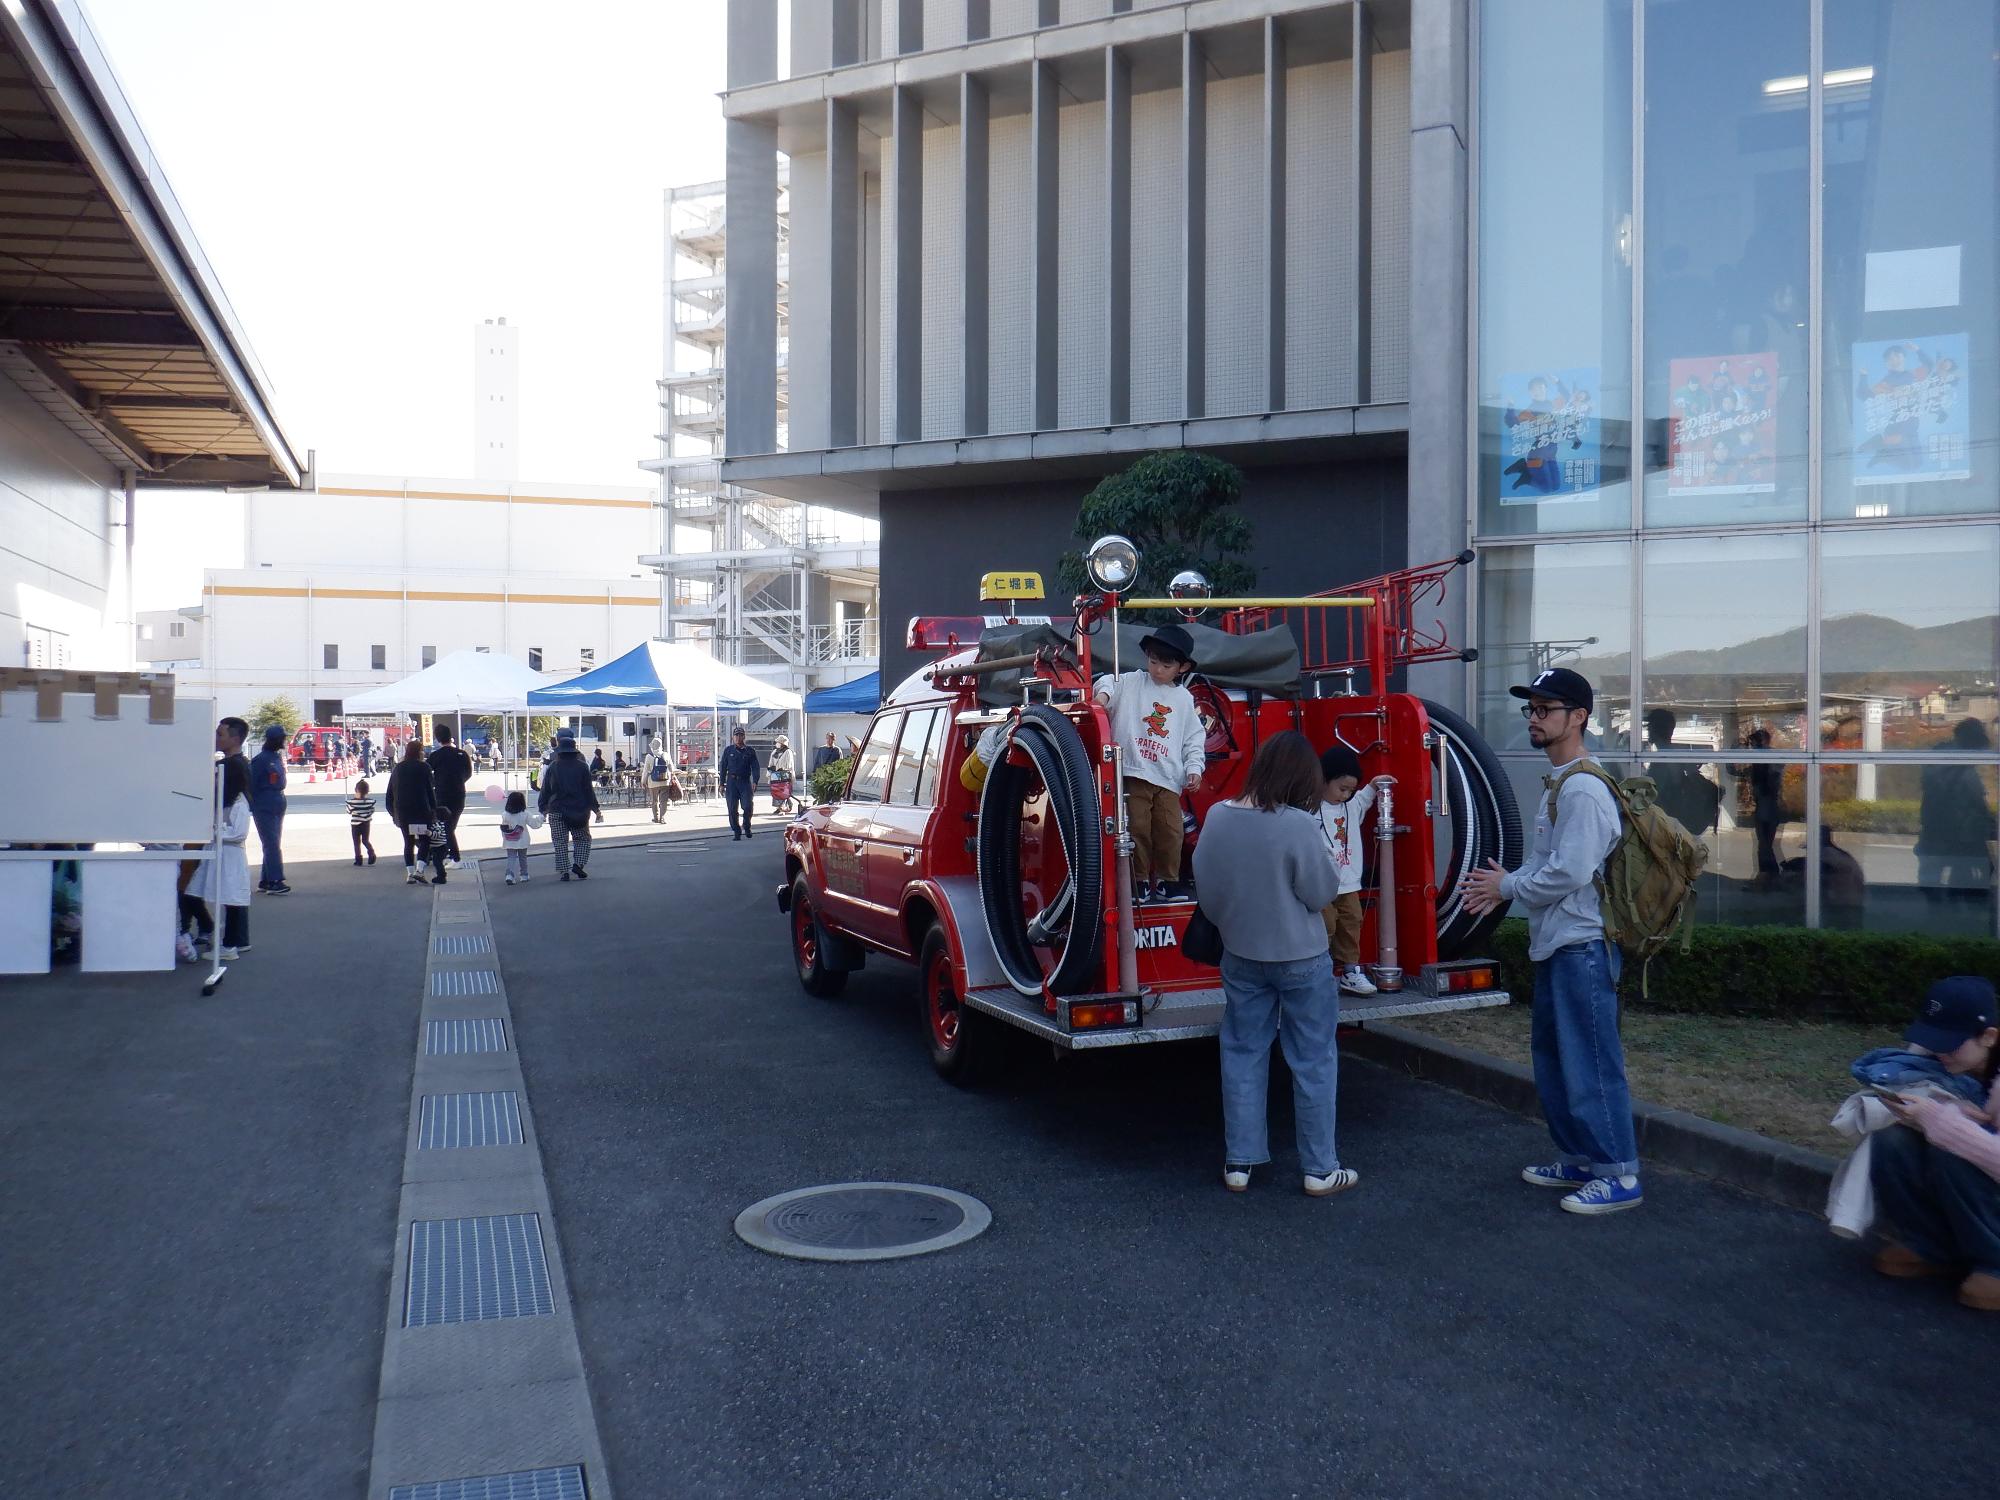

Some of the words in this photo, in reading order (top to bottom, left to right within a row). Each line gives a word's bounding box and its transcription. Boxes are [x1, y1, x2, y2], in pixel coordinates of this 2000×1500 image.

[994, 577, 1037, 591] 仁堀東
[1533, 670, 1555, 686] T
